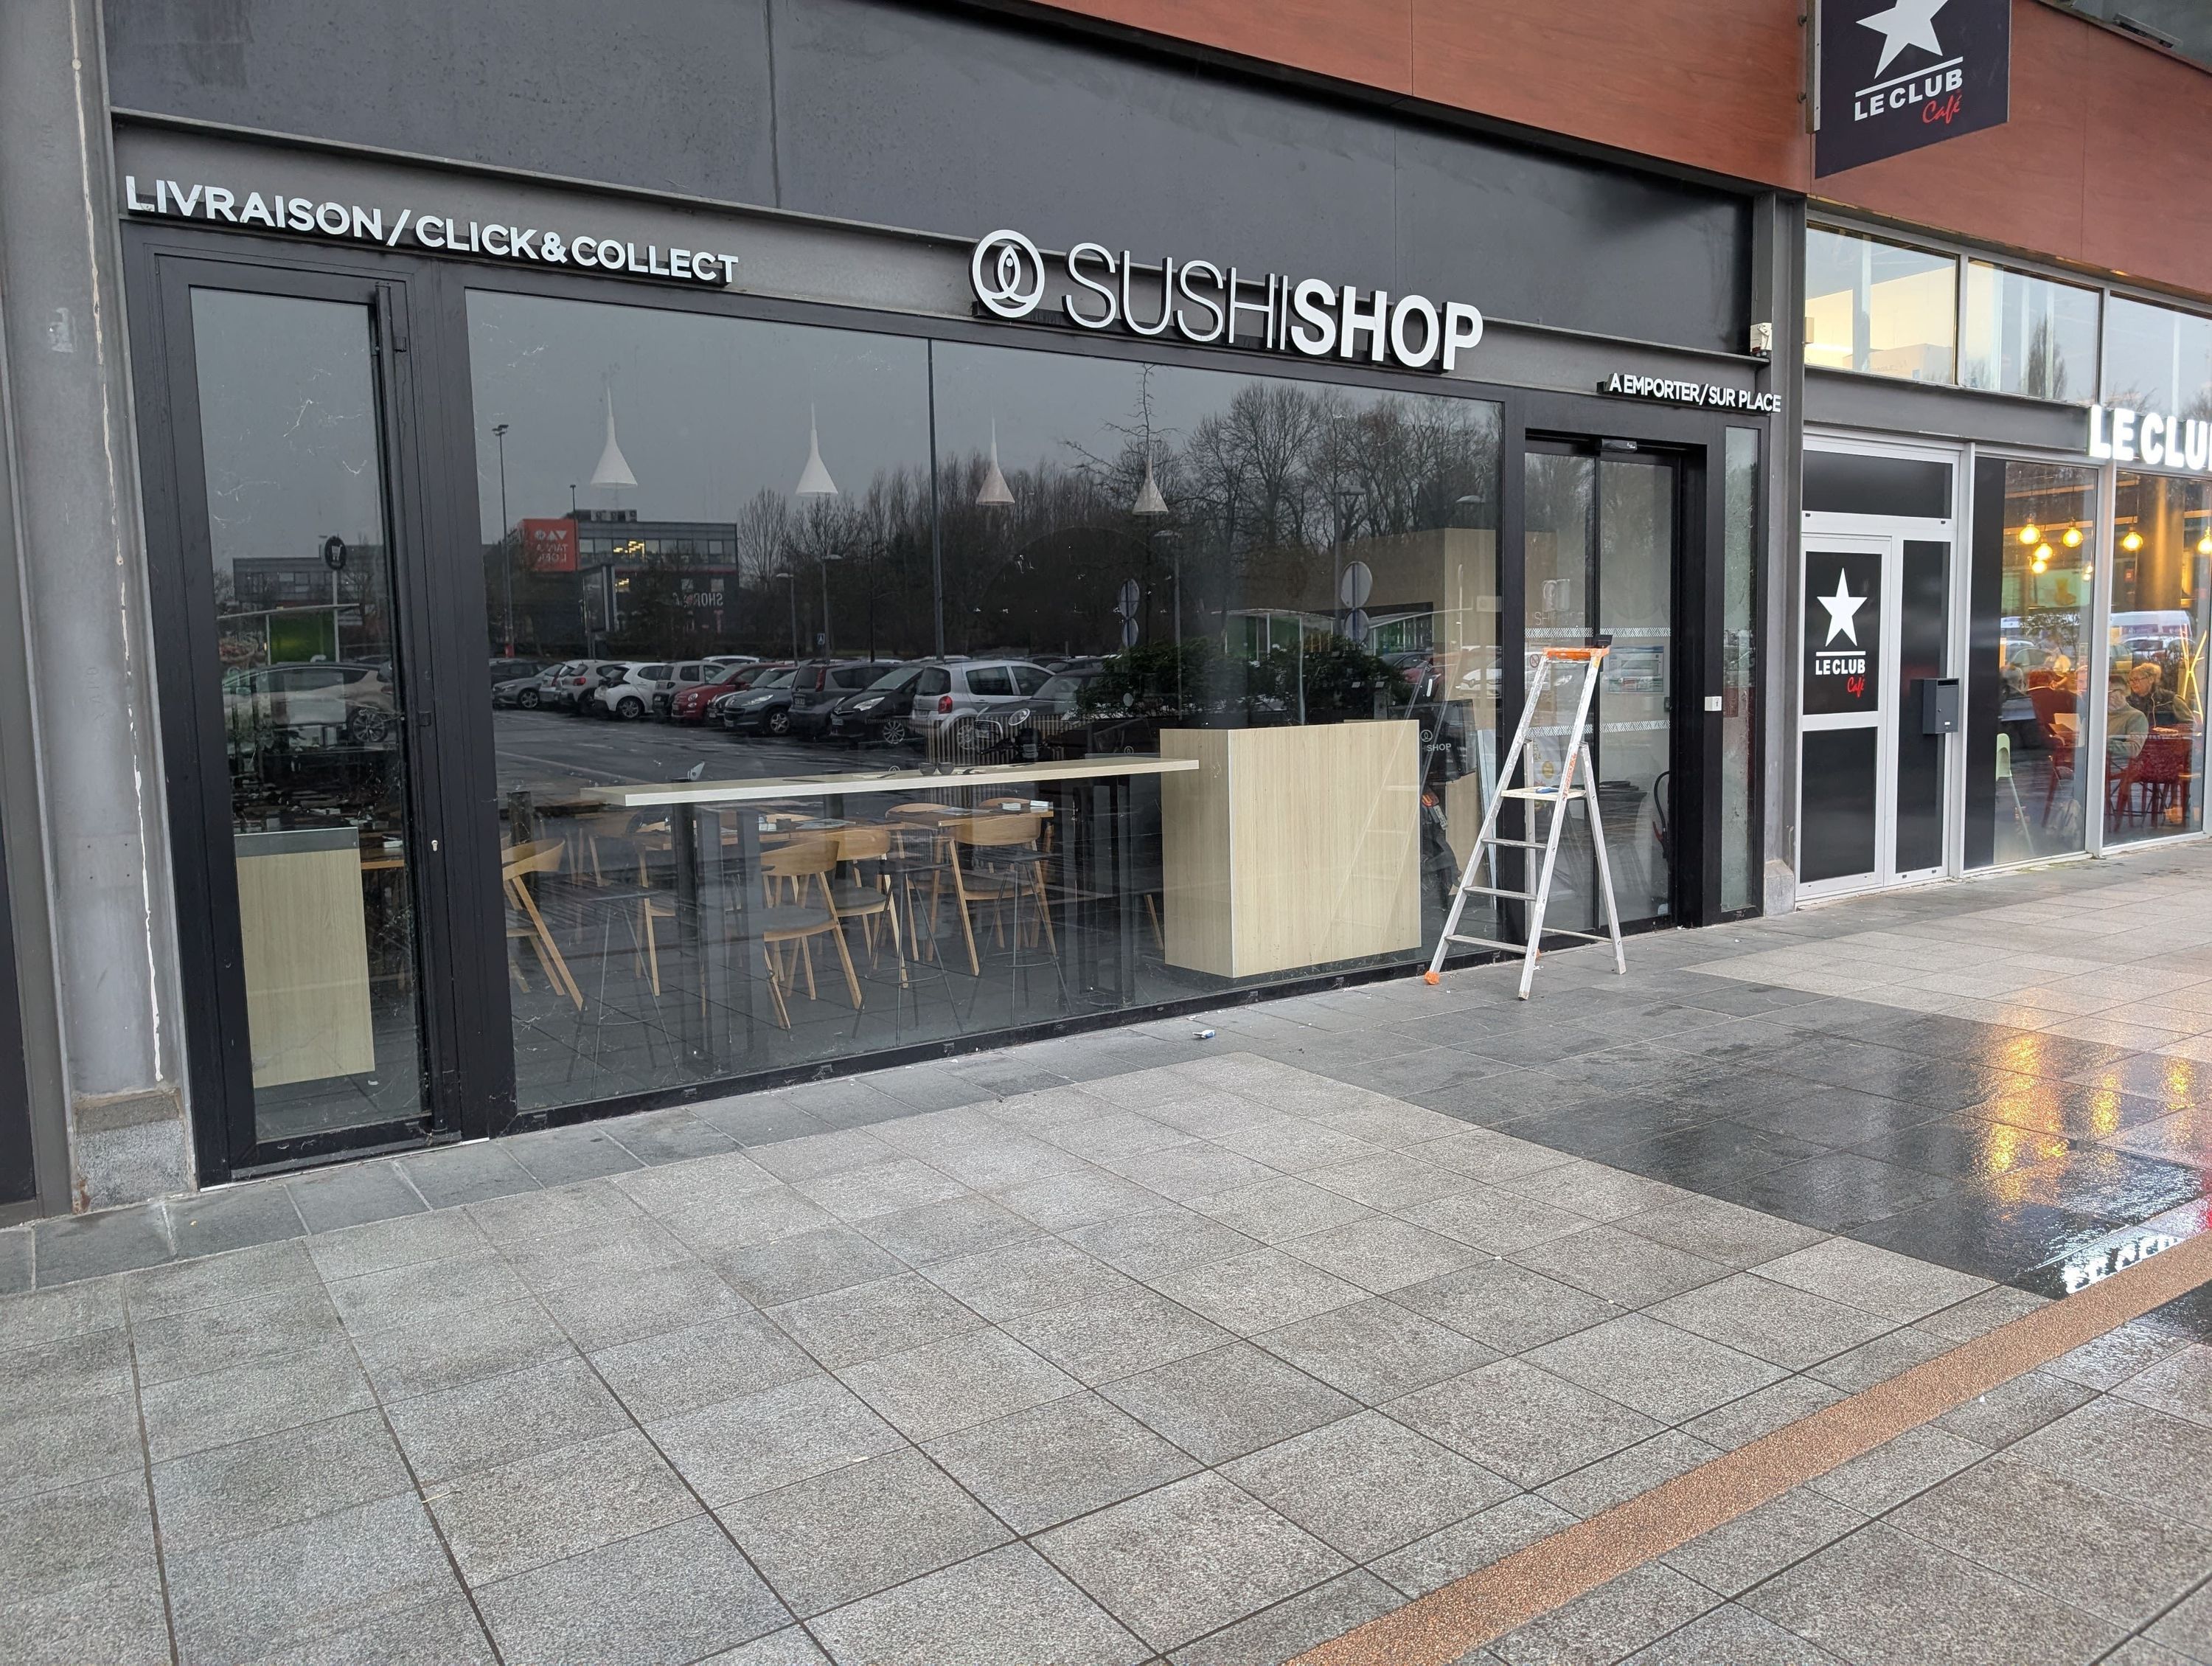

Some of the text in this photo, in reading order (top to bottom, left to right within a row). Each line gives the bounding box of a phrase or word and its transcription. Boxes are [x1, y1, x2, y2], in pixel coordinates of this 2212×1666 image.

[1854, 69, 1964, 122] LE CLUB
[1921, 94, 1963, 125] Café
[1738, 389, 1782, 413] PLACE
[2089, 404, 2212, 472] LE CLU
[1815, 659, 1865, 676] LE CLUB
[1847, 676, 1865, 698] Café
